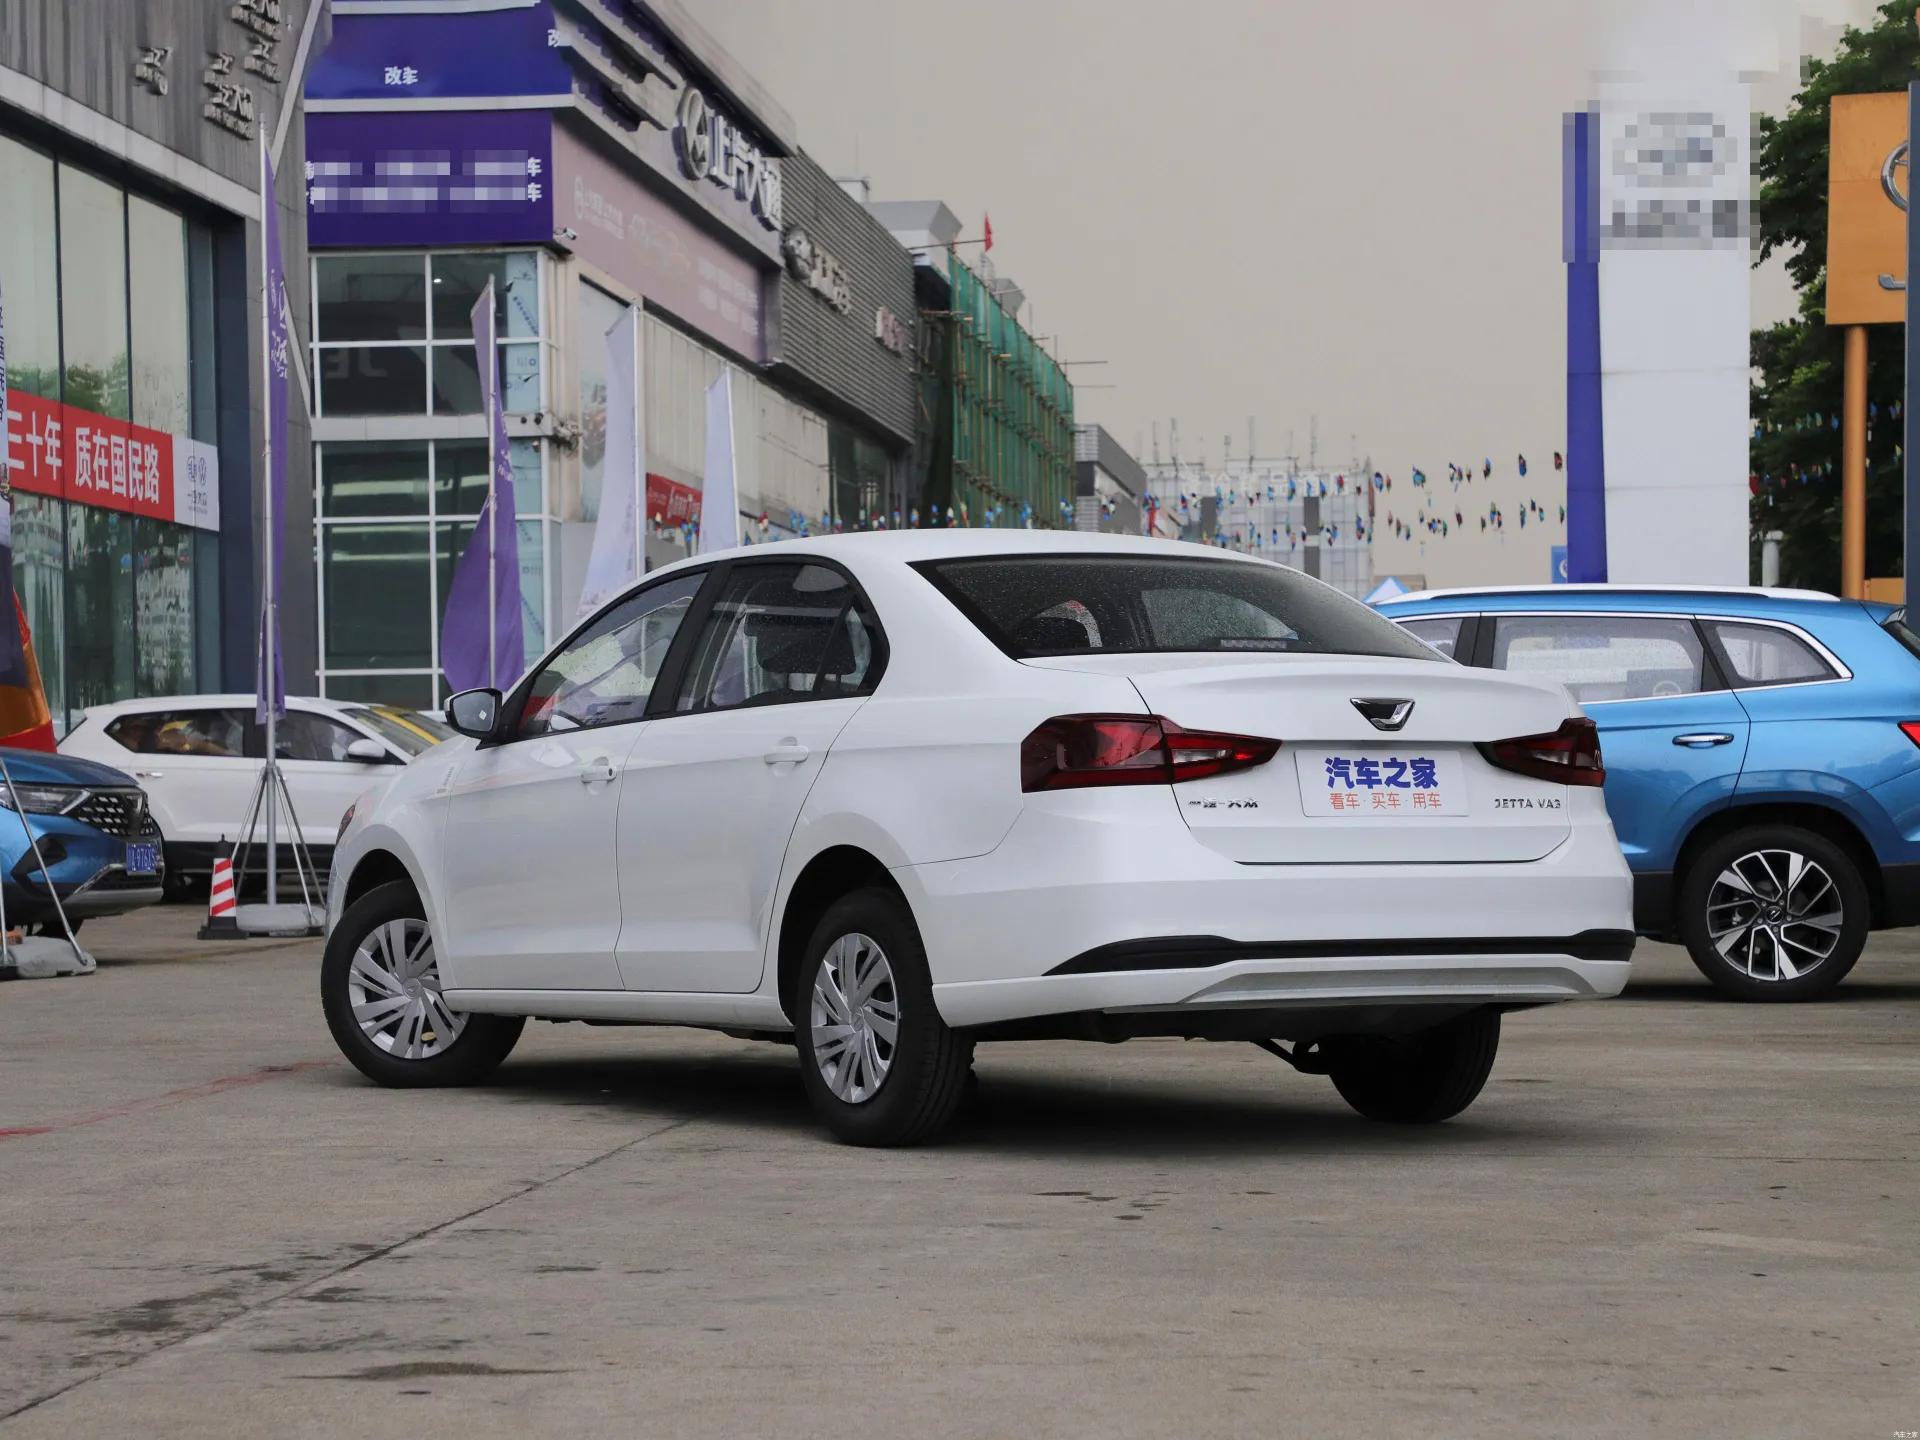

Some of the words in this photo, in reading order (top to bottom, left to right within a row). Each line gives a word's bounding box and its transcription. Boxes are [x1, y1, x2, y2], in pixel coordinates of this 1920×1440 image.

[75, 426, 160, 504] 质在国民路
[1324, 757, 1439, 789] 汽车之家
[1494, 798, 1534, 809] JETTA
[1537, 798, 1561, 809] VA3
